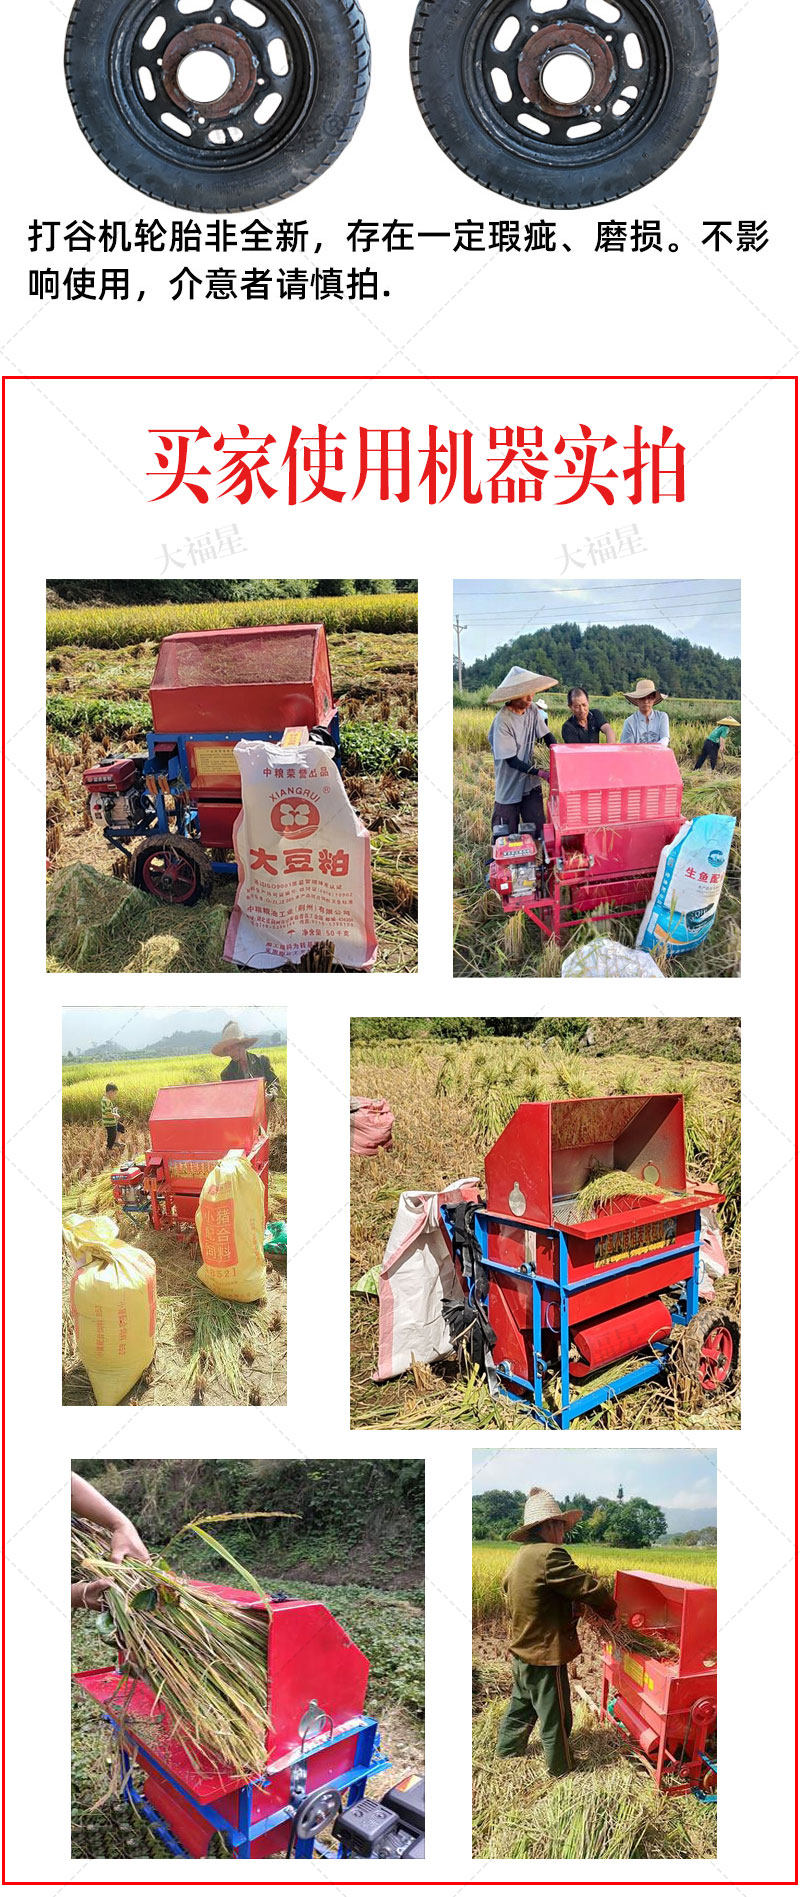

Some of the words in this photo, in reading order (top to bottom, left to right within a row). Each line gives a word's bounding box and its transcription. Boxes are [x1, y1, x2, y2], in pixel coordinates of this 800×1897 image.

[269, 786, 321, 803] XIANGRUI
[250, 848, 350, 877] 大豆粕
